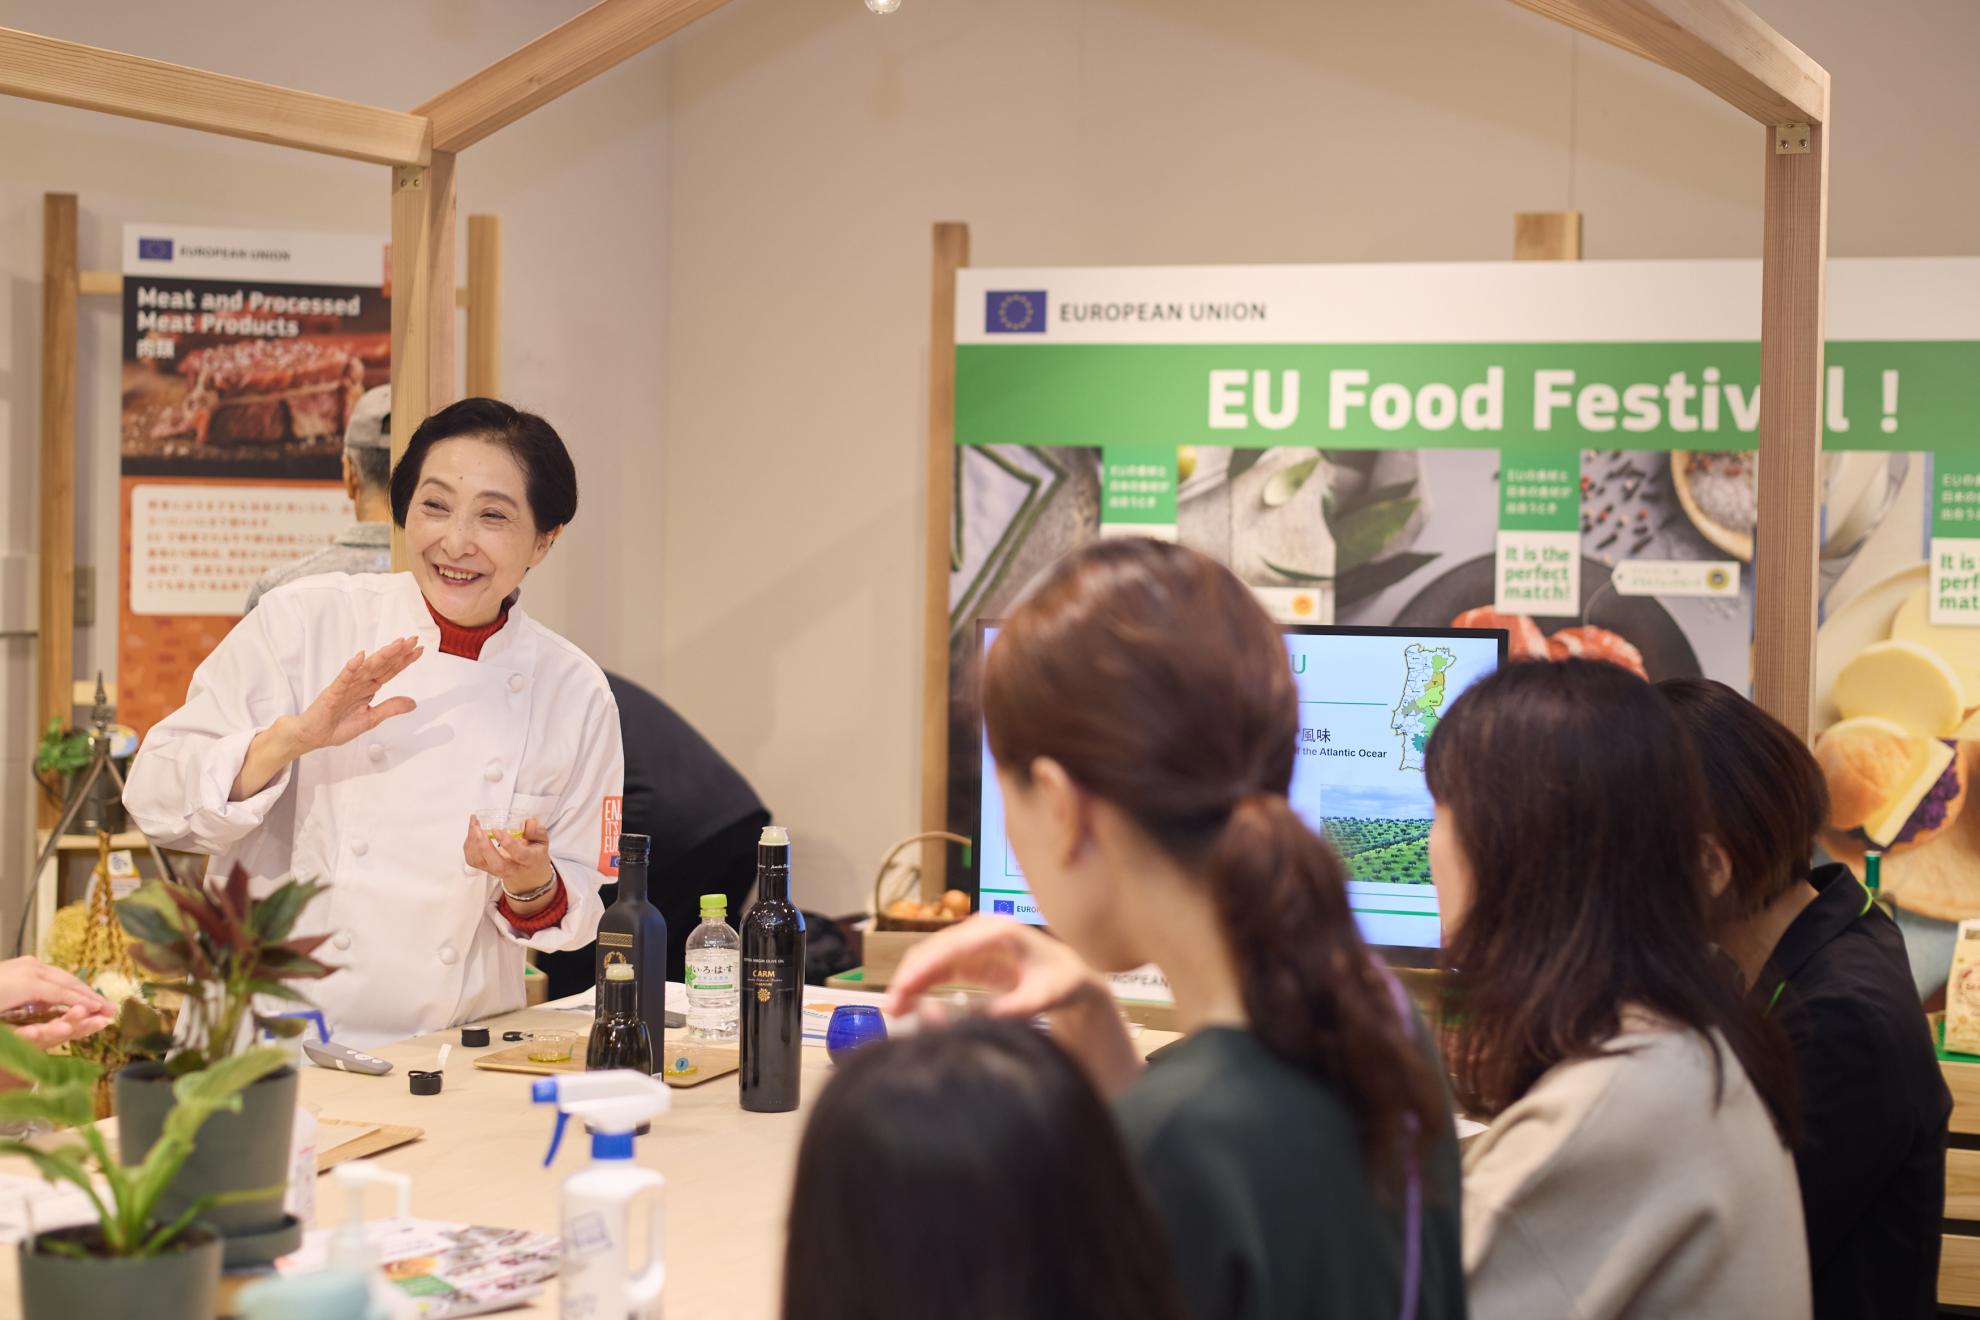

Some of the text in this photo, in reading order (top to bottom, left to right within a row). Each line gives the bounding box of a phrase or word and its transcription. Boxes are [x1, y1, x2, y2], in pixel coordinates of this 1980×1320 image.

[180, 244, 291, 262] EUROPEAN UNION
[137, 287, 361, 316] Meat and Processed
[1059, 302, 1267, 322] EUROPEAN UNION
[137, 311, 299, 337] Meat Products
[1208, 366, 1900, 433] EU Food Festivl !
[1505, 546, 1570, 562] It is the
[1940, 553, 1975, 570] It is
[1504, 565, 1569, 582] perfect
[1504, 583, 1571, 600] match!
[1302, 728, 1331, 743] 風味
[1302, 747, 1318, 756] the
[1319, 748, 1356, 757] Atlantic
[752, 970, 775, 978] CARM
